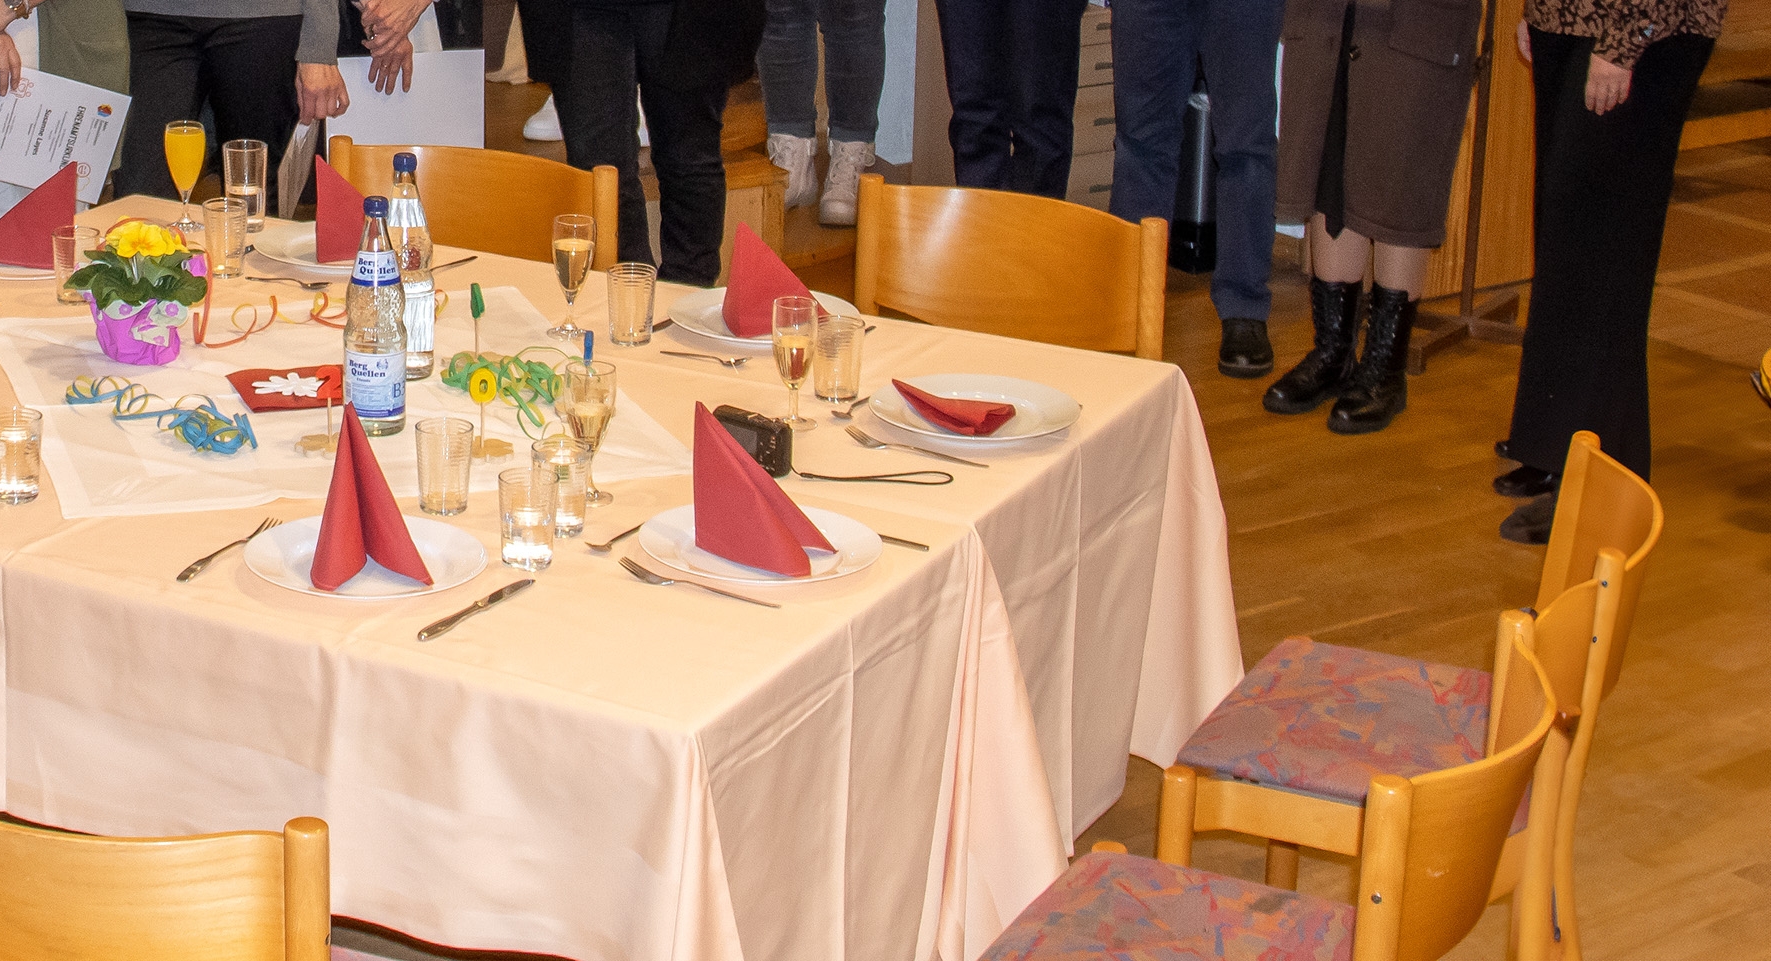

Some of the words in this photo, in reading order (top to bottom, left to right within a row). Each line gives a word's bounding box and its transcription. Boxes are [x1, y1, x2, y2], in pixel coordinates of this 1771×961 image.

[38, 109, 53, 136] Susanne
[59, 105, 87, 170] EHRENAMTSURKUND
[349, 359, 368, 370] Berg
[351, 367, 386, 377] Quellen
